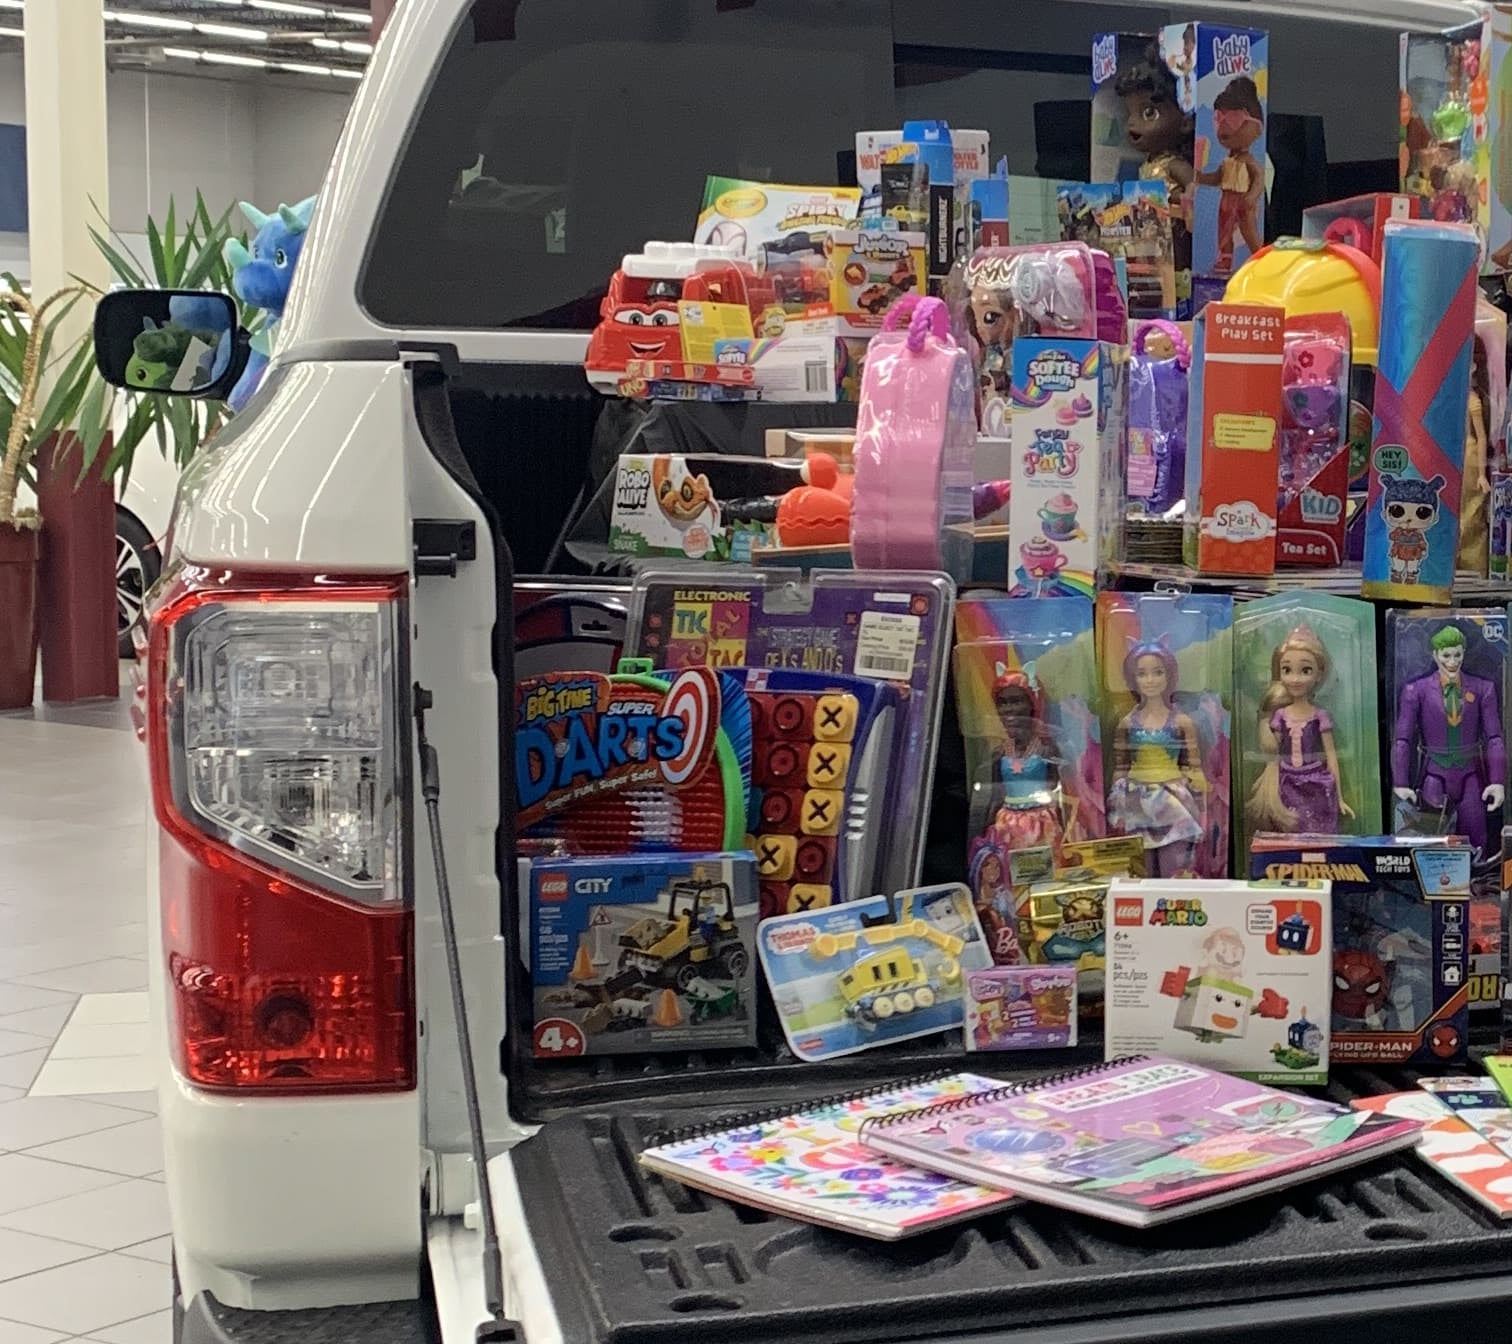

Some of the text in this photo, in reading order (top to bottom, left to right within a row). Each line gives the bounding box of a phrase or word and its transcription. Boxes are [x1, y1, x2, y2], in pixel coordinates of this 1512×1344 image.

[1213, 34, 1250, 60] baby
[786, 203, 847, 218] SPIDEY
[1215, 313, 1281, 327] Breakfast
[1221, 328, 1274, 341] Play Set
[1029, 360, 1080, 376] SOFTEE
[620, 379, 646, 397] UNO
[1035, 374, 1076, 388] Dough
[1381, 451, 1401, 460] HEY
[620, 469, 650, 488] ROBO
[617, 488, 649, 505] ALIVE
[1302, 494, 1341, 516] KID
[1217, 510, 1260, 528] Spark
[1282, 542, 1327, 554] Tea Set
[673, 590, 751, 602] ELECTRONIC
[1483, 624, 1504, 639] DC
[709, 648, 744, 668] TAC
[608, 702, 655, 716] SUPER
[515, 714, 685, 807] DARTS
[600, 775, 628, 790] Super
[1375, 855, 1410, 865] WORLD
[1264, 863, 1371, 883] SPIDER-MAN
[541, 877, 613, 895] LEGO CITY
[1115, 897, 1203, 918] LEGO SUPER
[1149, 909, 1208, 927] MARIO
[1113, 931, 1129, 942] 6+
[539, 1026, 579, 1052] 4+
[1258, 1073, 1320, 1081] EXPANSION SET
